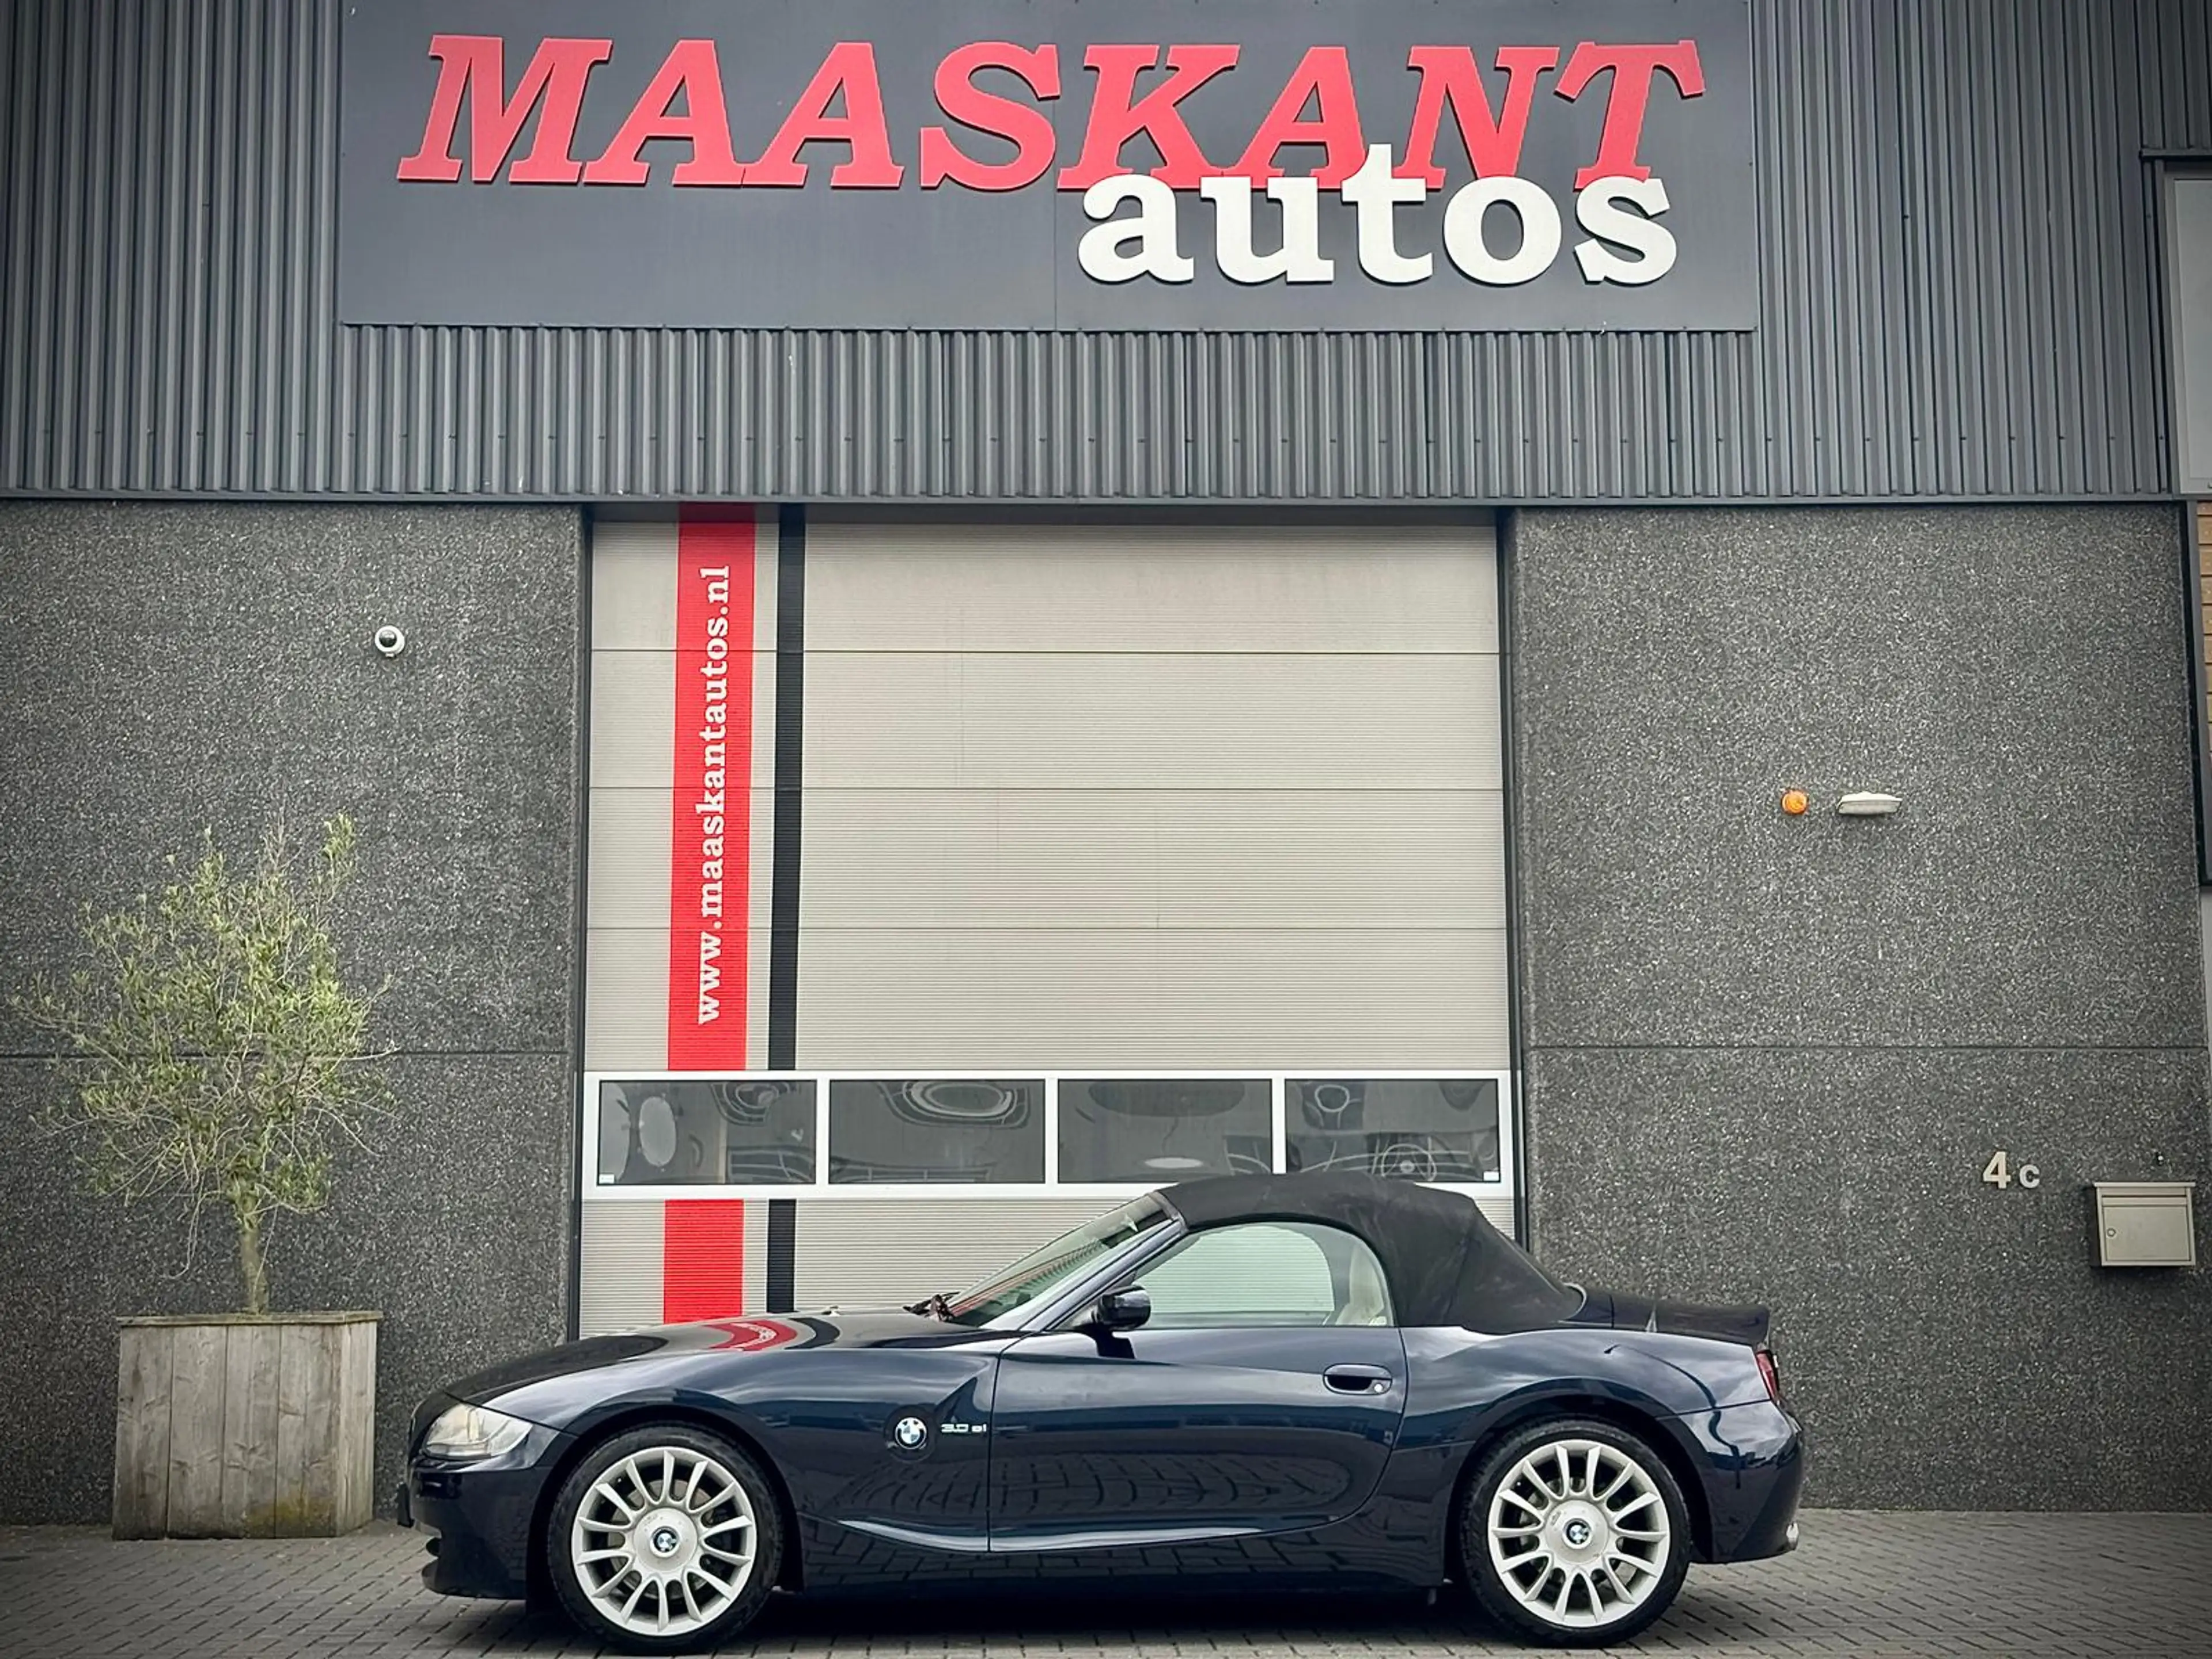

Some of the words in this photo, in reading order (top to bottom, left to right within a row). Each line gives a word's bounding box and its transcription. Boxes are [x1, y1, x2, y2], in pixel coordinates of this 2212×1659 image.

[398, 35, 1705, 189] MAASKANT
[1078, 143, 1677, 286] autos
[697, 565, 730, 1025] www.maaskantautos.nl
